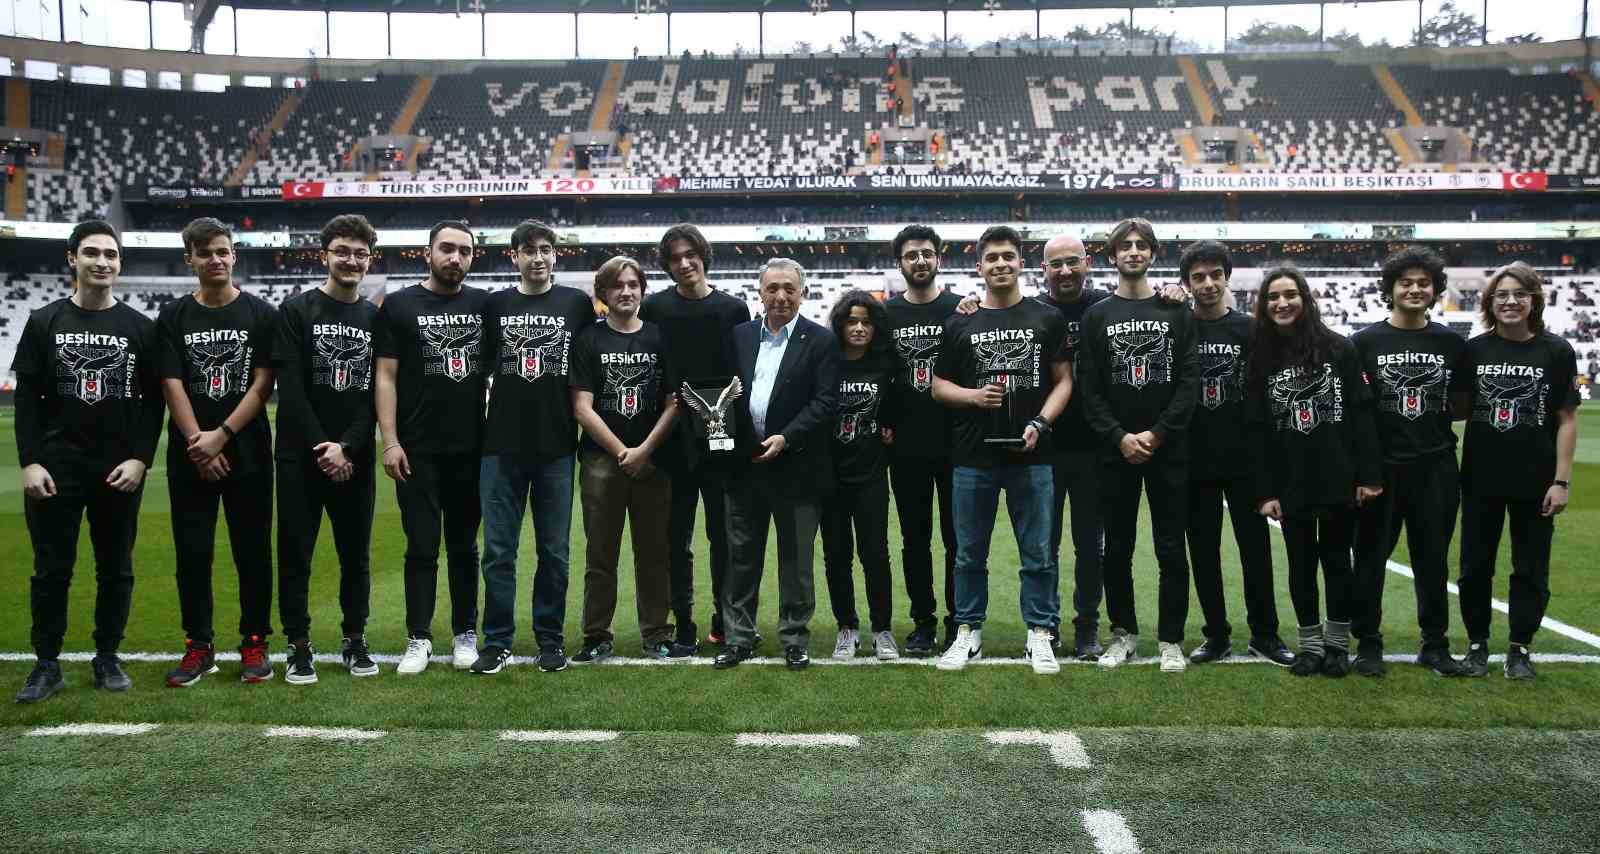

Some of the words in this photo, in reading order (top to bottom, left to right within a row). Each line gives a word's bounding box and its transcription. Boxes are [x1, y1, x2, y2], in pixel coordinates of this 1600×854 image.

[431, 182, 529, 194] SPORUNUN
[542, 180, 595, 193] 120
[679, 177, 741, 190] MEHMET
[744, 176, 792, 189] VEDAT
[795, 175, 857, 188] ULURAK
[500, 312, 566, 329] BEŞİKTAŞ
[1106, 318, 1169, 337] BEŞİKTAŞ
[184, 328, 249, 346] BEŞİKTAŞ
[312, 321, 372, 344] BEŞİKTAŞ
[893, 323, 943, 339] BEŞİKTA
[970, 328, 1034, 345] BEŞİKTAŞ
[55, 330, 129, 350] BEŞİKTAŞ
[600, 351, 657, 366] BEŞİKTAŞ
[1377, 350, 1446, 367] BEŞİKTAŞ
[1476, 362, 1545, 381] BEŞİKTAŞ
